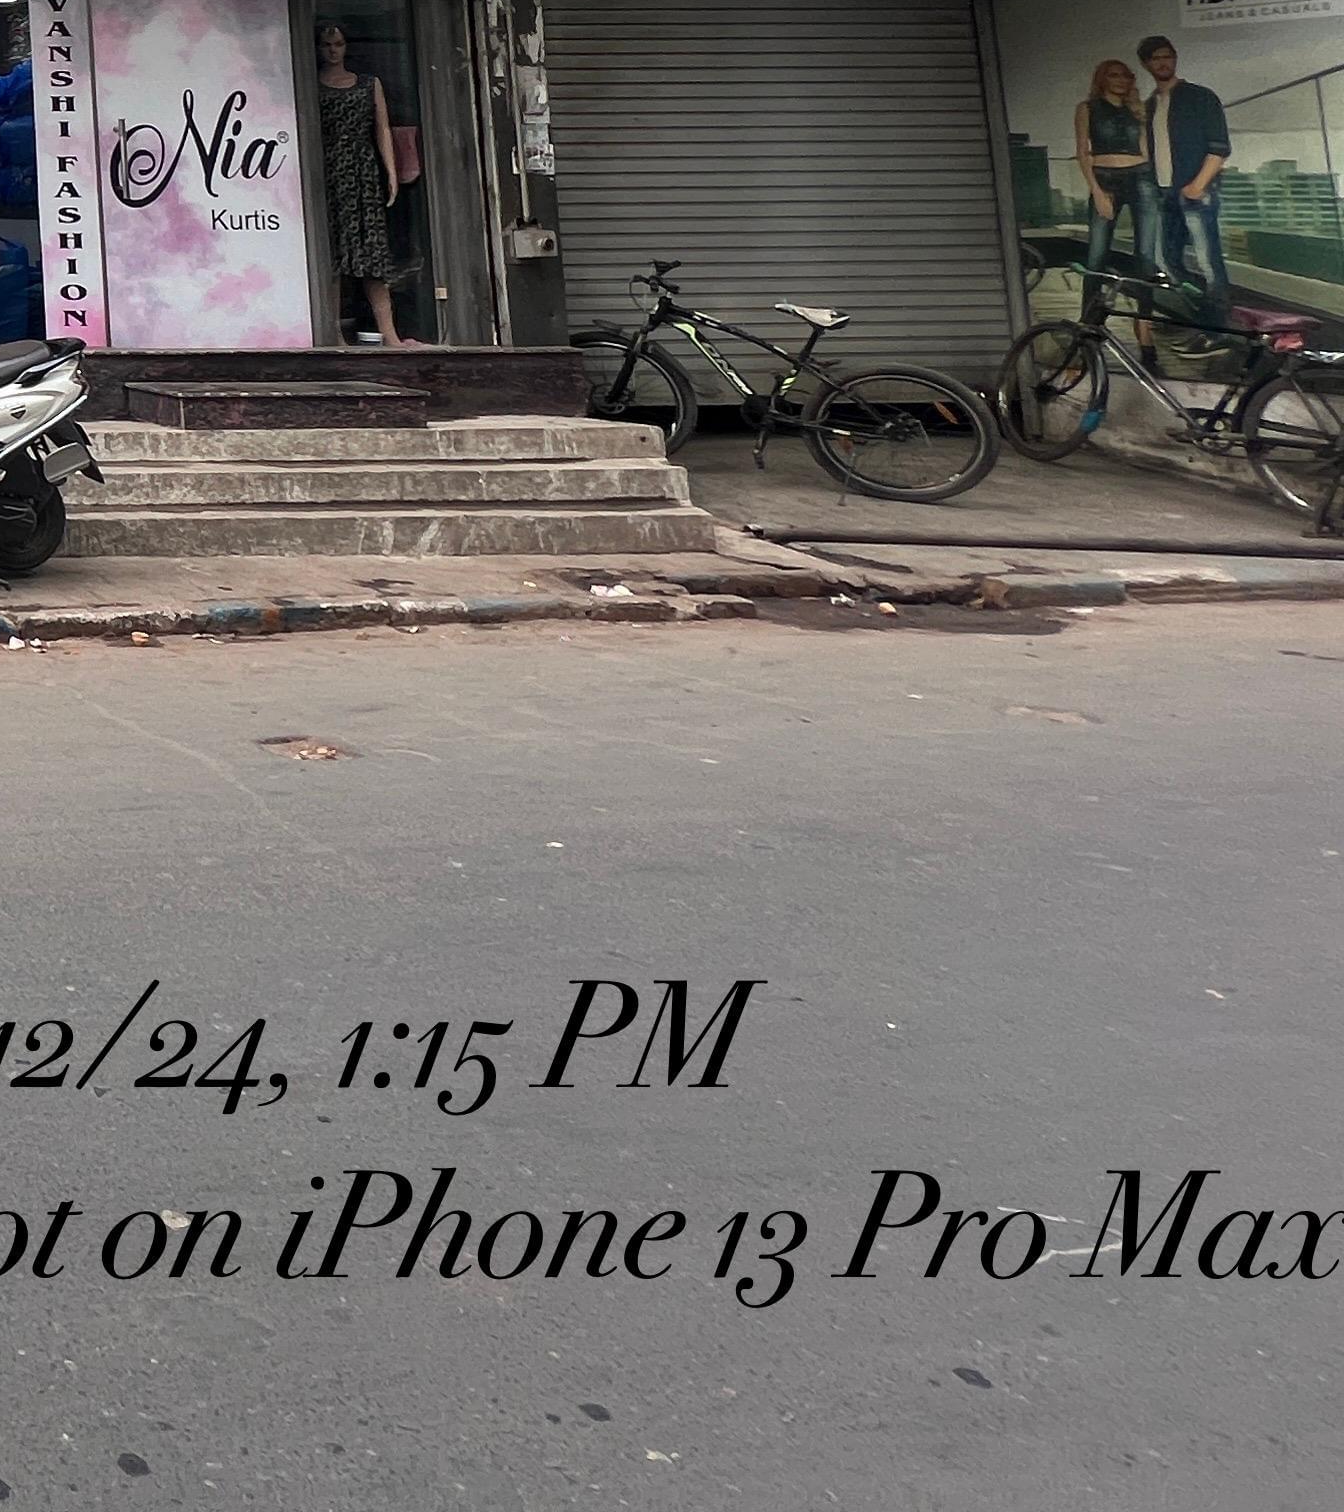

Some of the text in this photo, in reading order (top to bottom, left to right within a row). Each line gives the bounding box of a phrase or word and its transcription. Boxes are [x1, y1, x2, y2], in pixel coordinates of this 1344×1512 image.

[110, 89, 288, 209] Nia
[54, 155, 88, 328] FASHION
[211, 209, 281, 231] Kurtis
